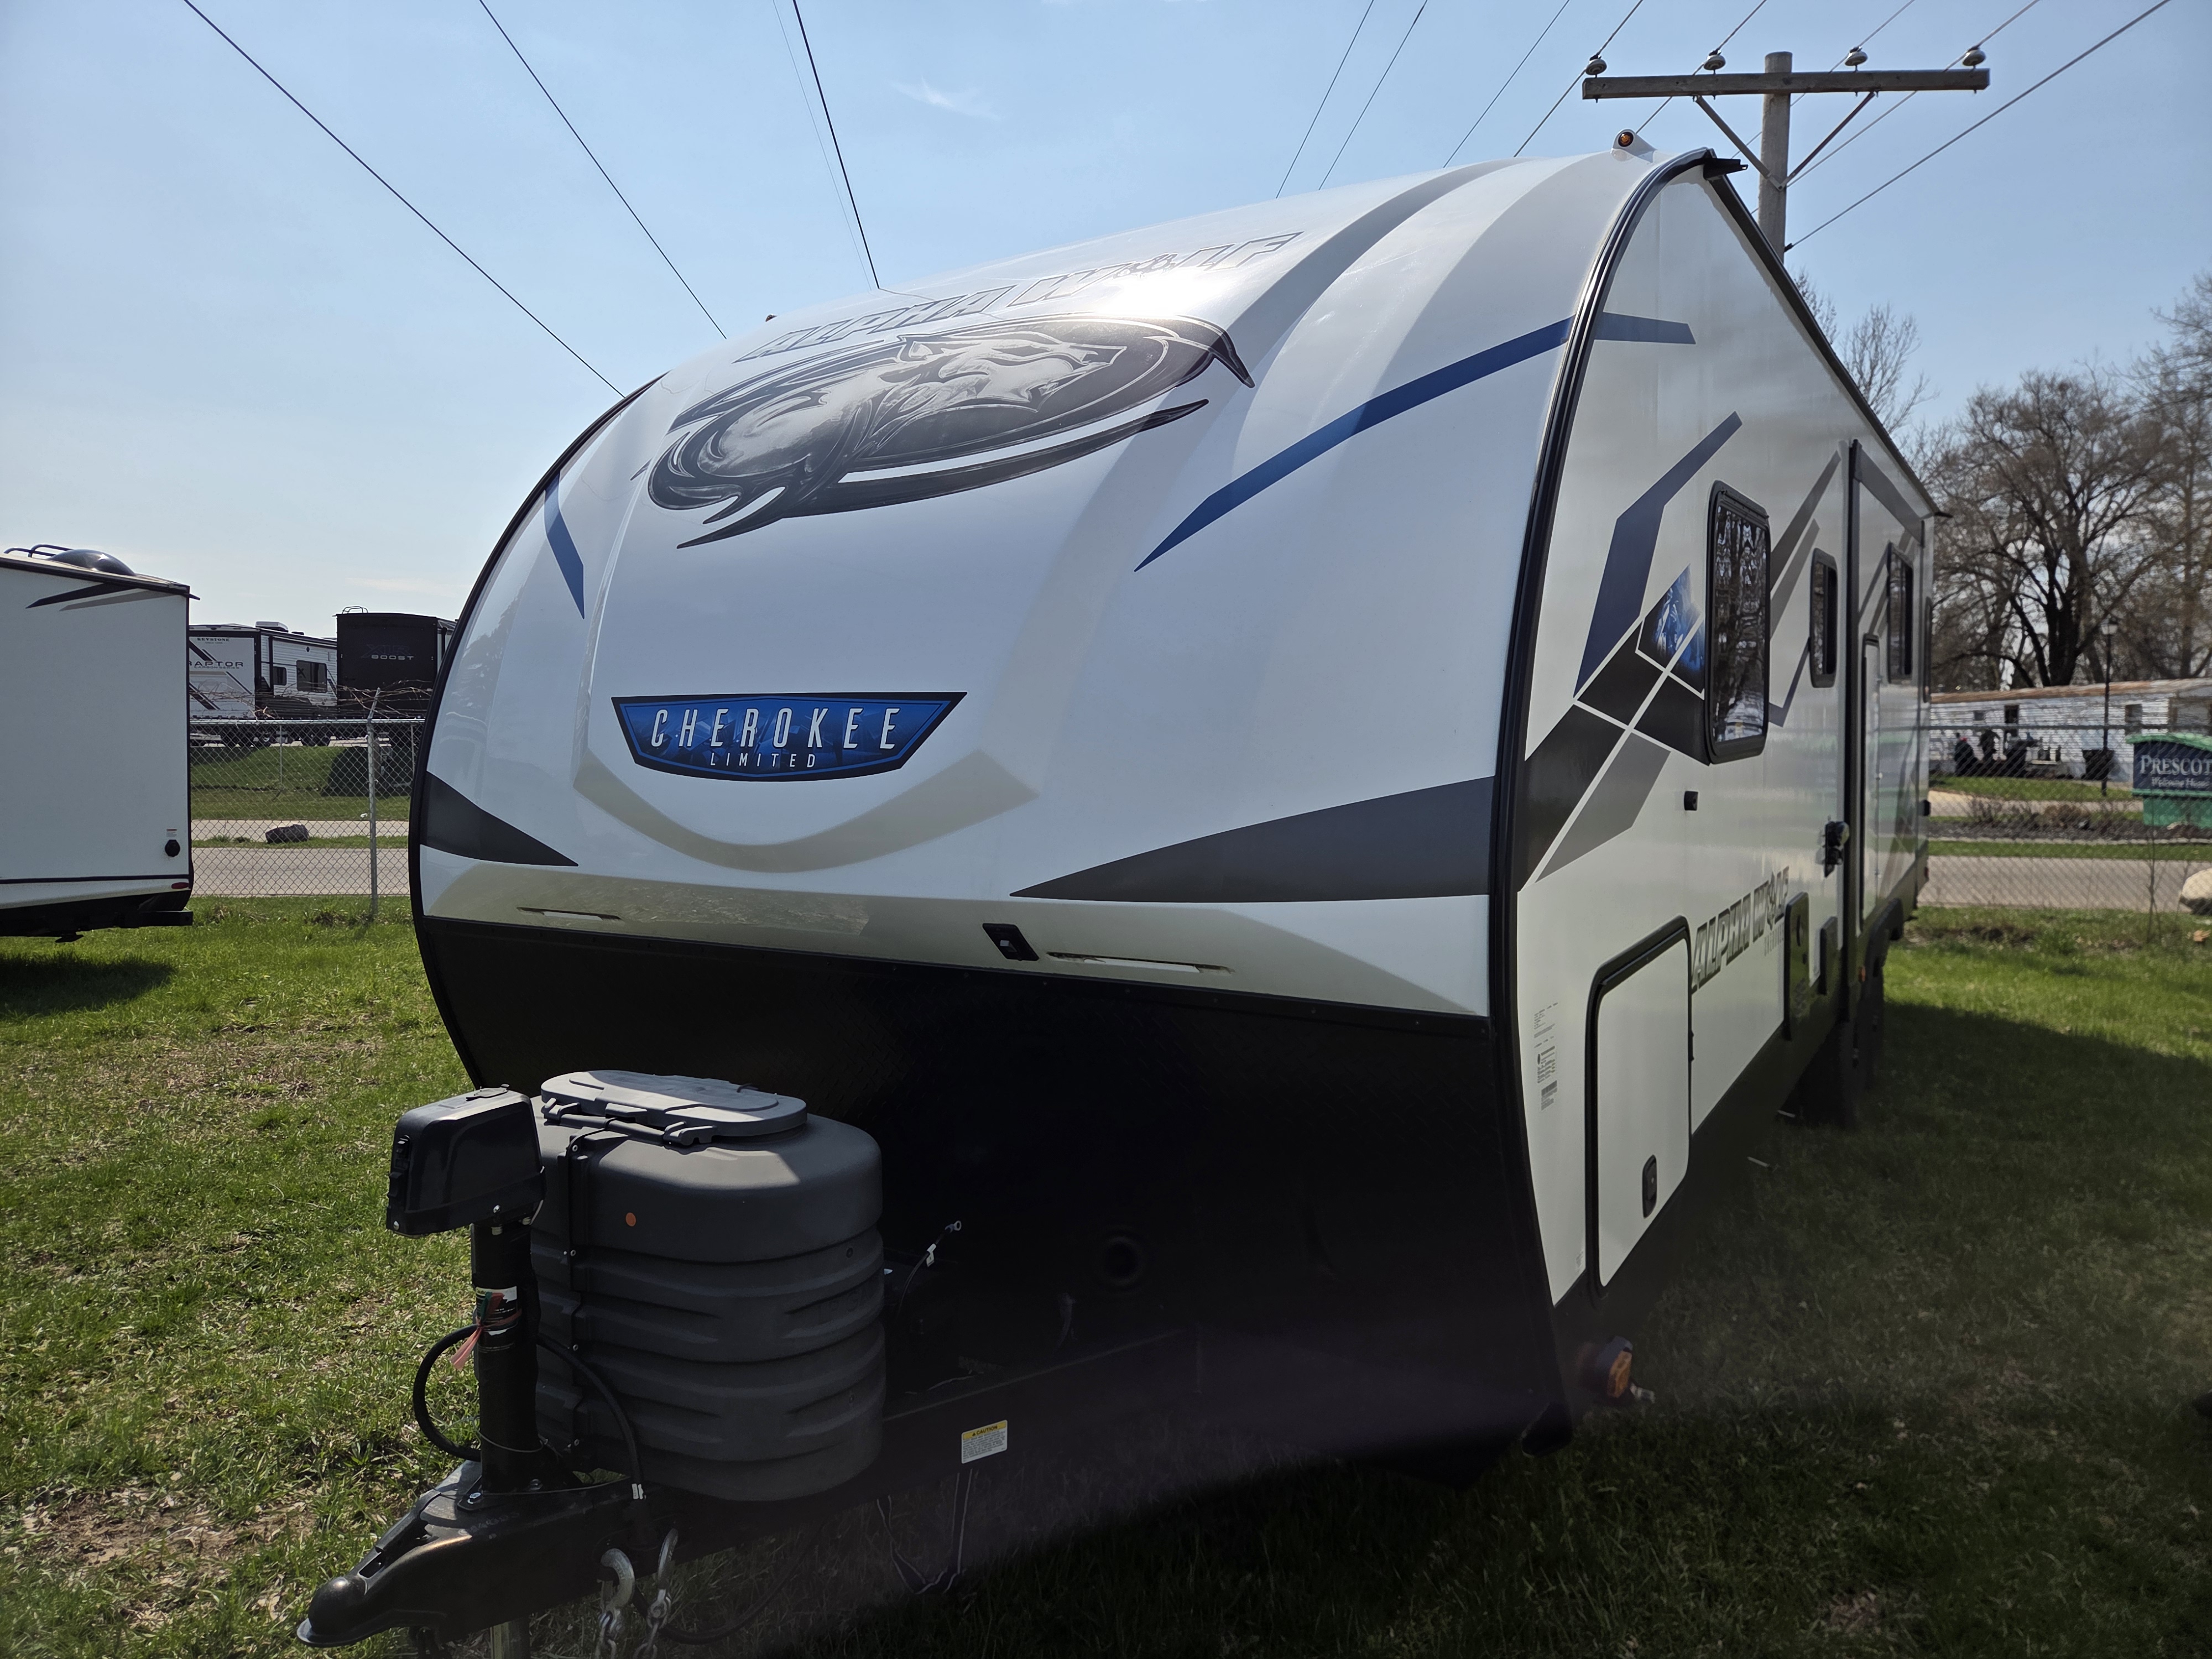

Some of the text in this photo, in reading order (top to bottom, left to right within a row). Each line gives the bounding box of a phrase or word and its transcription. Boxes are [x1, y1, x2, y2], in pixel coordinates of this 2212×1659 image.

[732, 284, 1016, 363] ALPHA
[651, 708, 900, 750] CHEROKEE
[711, 753, 816, 768] LIMITED
[1691, 893, 1751, 995] ALPHA
[976, 1425, 998, 1436] CAUTION
